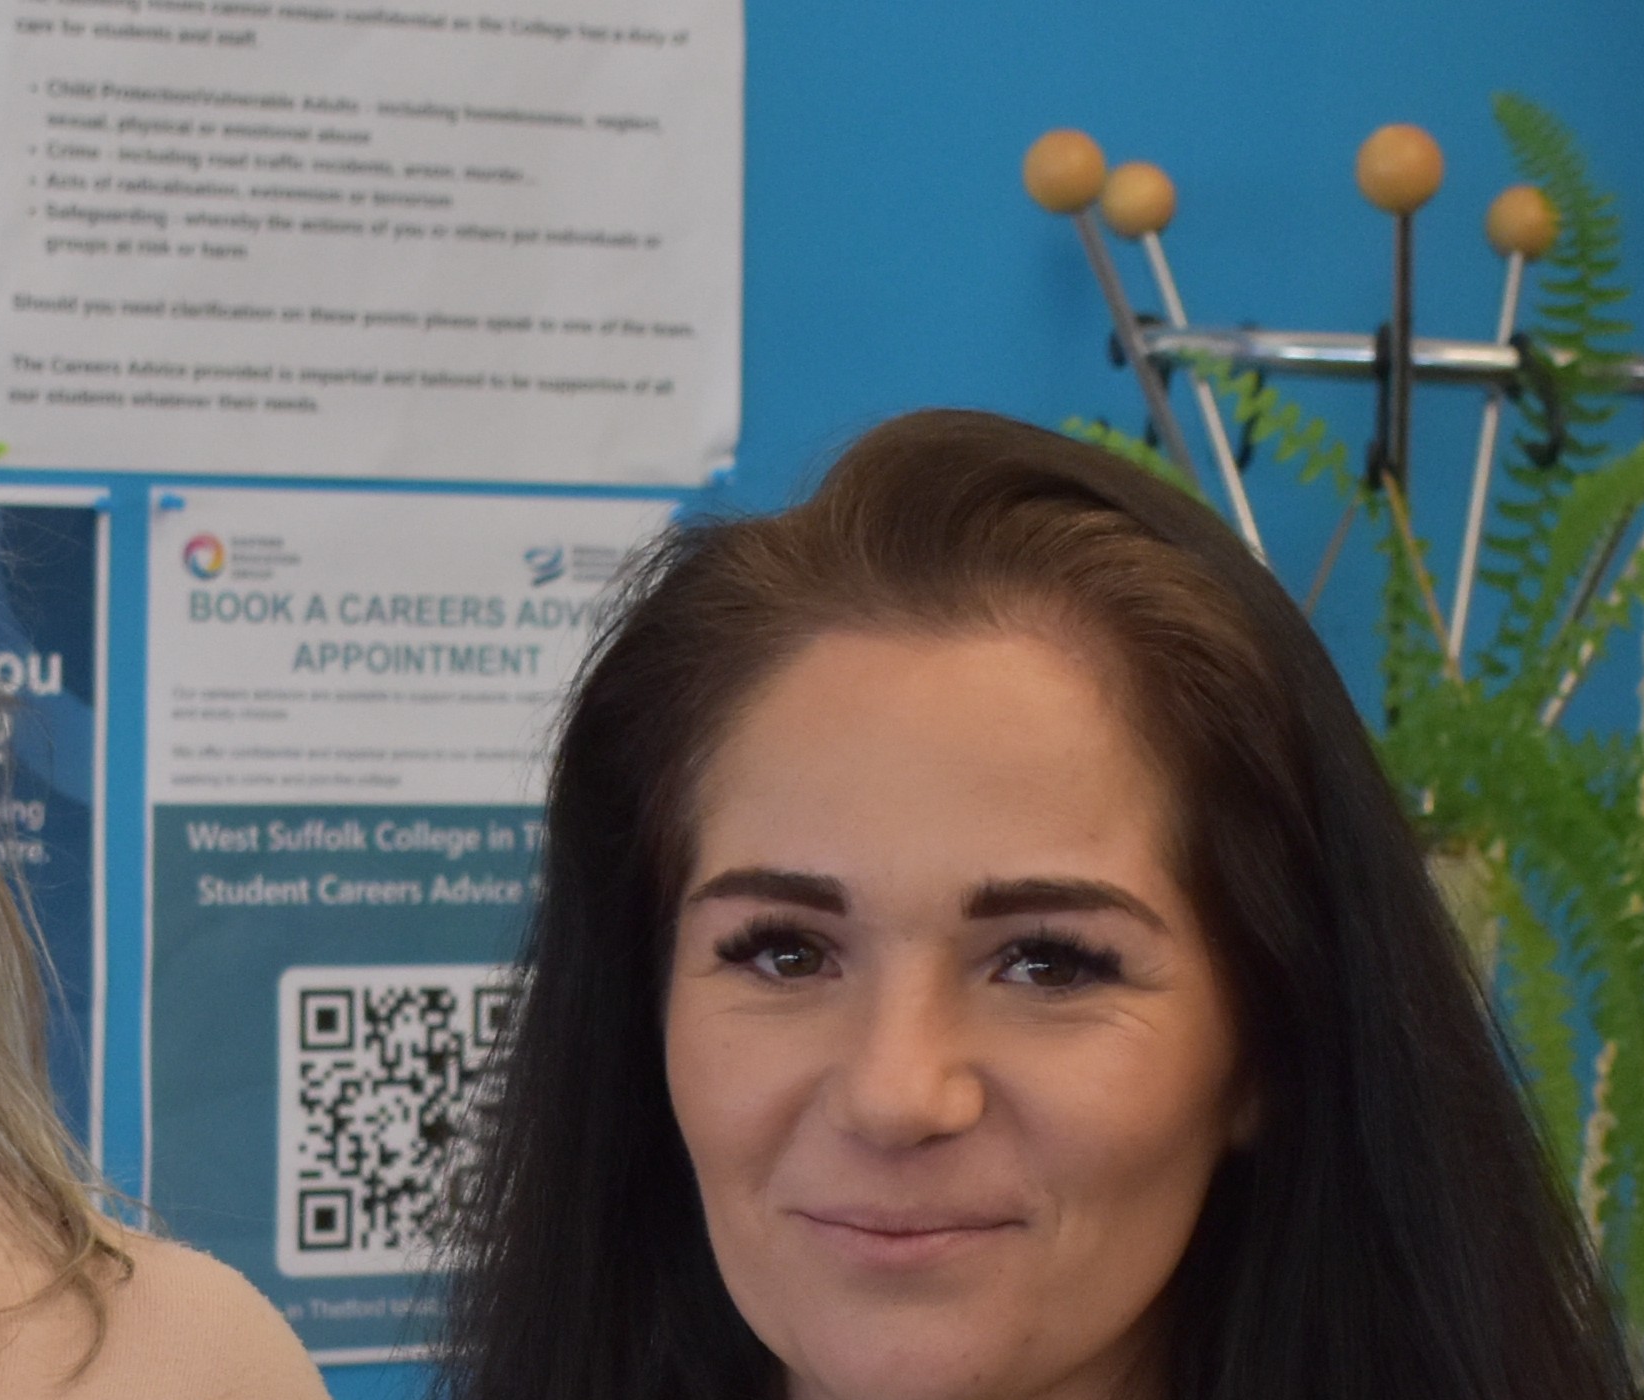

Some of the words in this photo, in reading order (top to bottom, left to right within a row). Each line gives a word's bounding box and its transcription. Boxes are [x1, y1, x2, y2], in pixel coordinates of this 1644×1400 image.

[189, 590, 293, 623] BOOK
[305, 593, 328, 624] A
[339, 592, 506, 628] CAREERS
[515, 596, 588, 630] ADV
[293, 641, 541, 675] APPOINTMENT
[185, 821, 258, 852] West
[267, 821, 367, 852] Suffolk
[374, 822, 481, 860] College
[487, 822, 515, 850] in
[198, 874, 309, 906] Student
[317, 874, 423, 905] Careers
[430, 873, 523, 901] Advice
